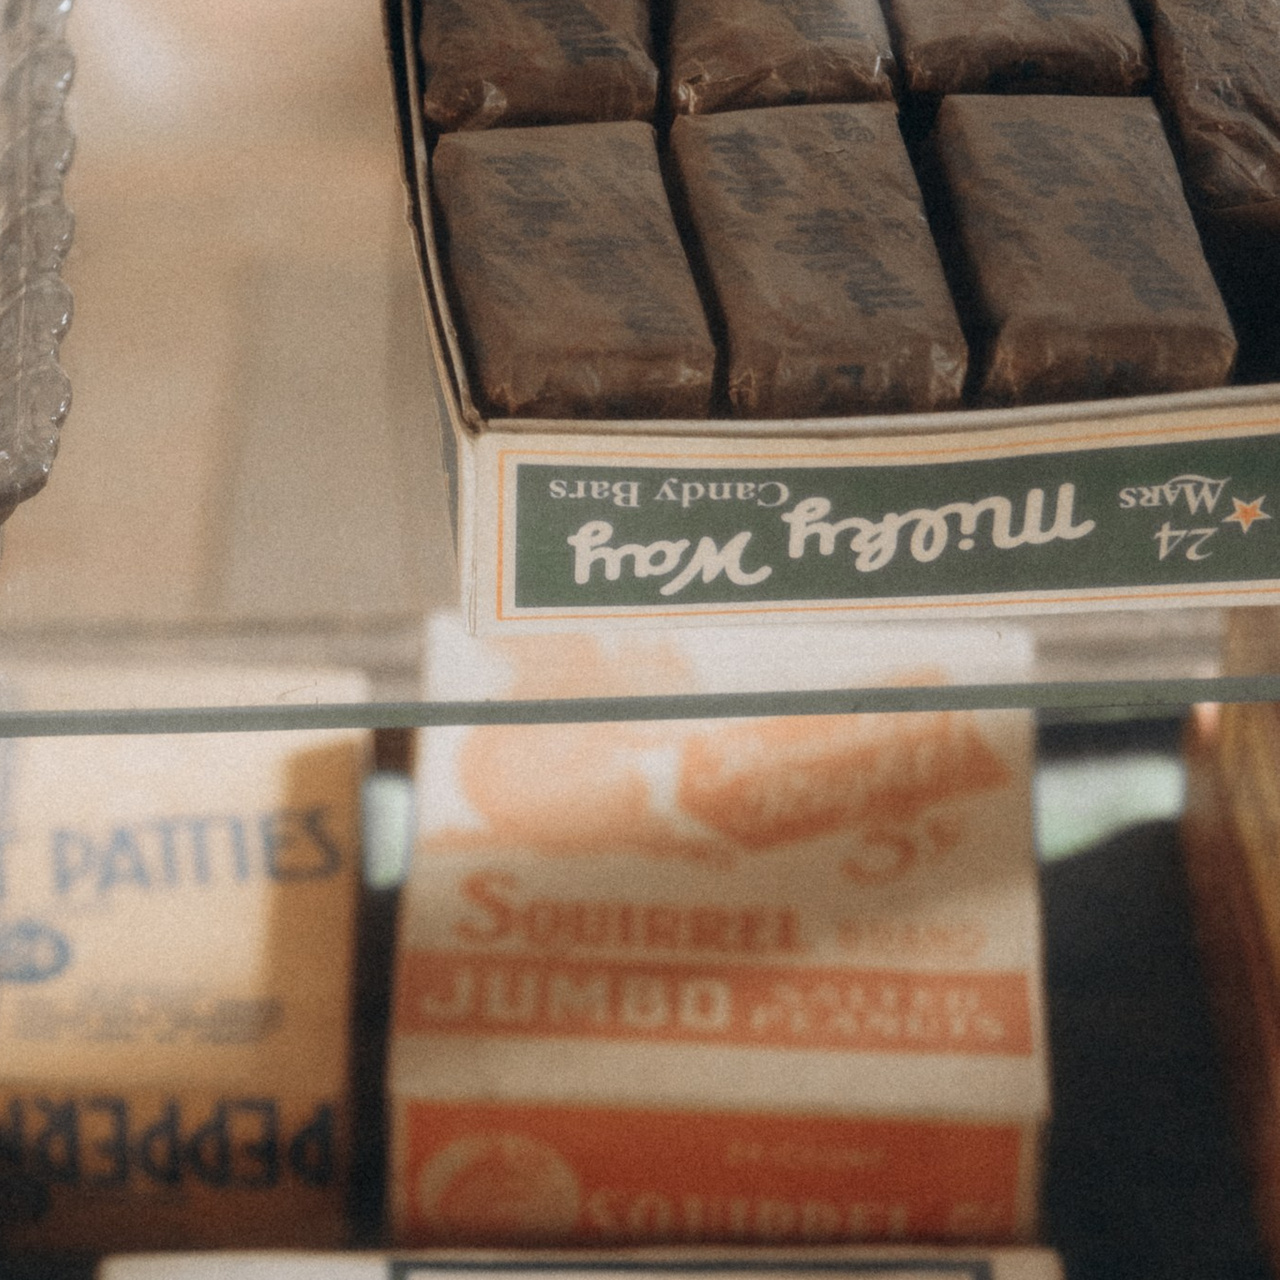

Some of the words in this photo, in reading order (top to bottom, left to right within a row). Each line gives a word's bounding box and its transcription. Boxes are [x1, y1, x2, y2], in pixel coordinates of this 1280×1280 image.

[548, 477, 639, 508] Bars
[653, 477, 791, 509] Candy
[781, 481, 1096, 572] Milky
[567, 519, 774, 597] Way
[1154, 519, 1215, 562] 24
[48, 800, 346, 896] PATTIES
[424, 966, 734, 1034] JUMBO
